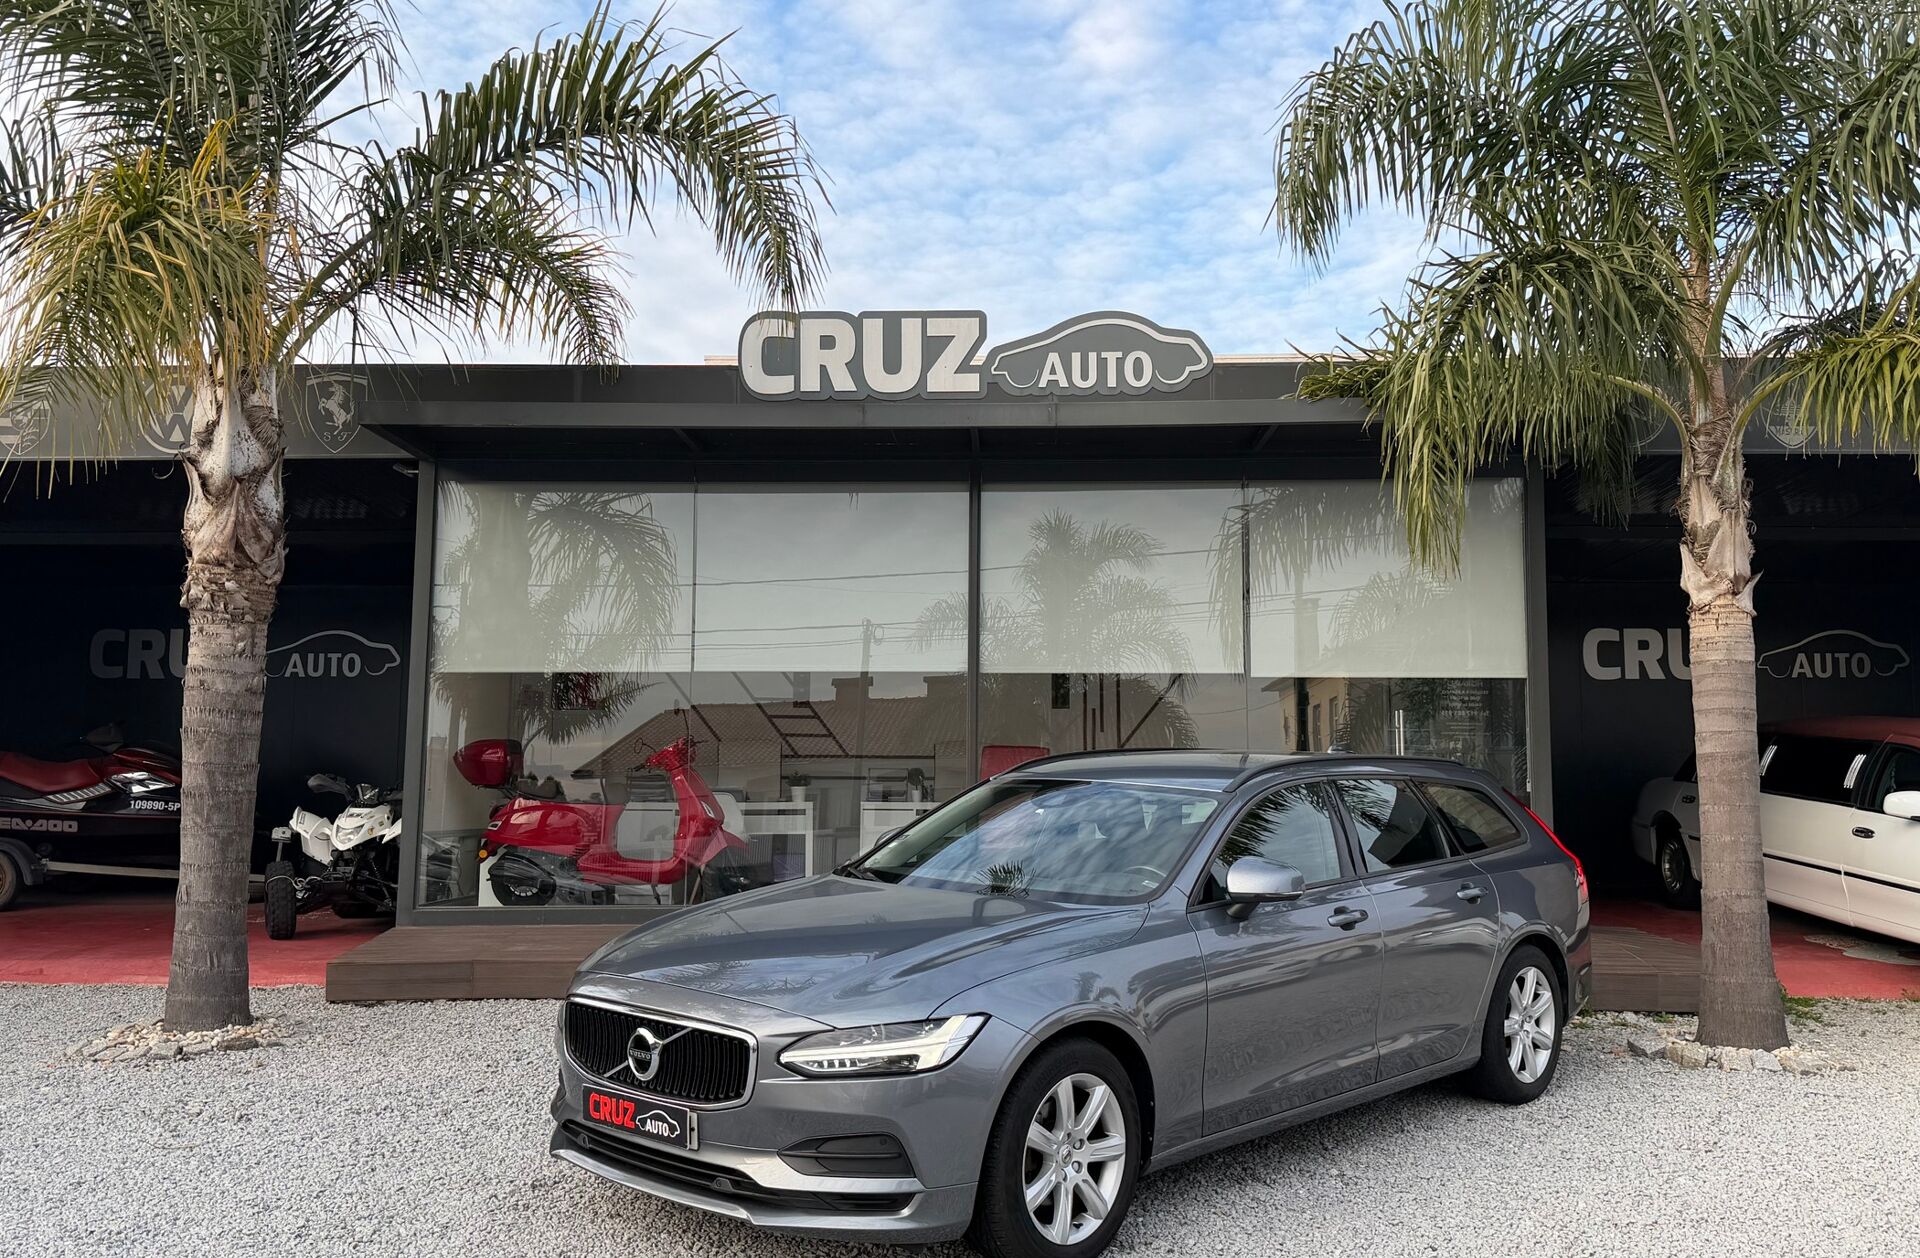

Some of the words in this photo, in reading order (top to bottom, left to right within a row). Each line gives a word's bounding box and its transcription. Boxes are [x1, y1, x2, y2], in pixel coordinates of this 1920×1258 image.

[741, 317, 980, 395] CRUZ
[1038, 350, 1153, 389] AUTO
[88, 628, 188, 680] CR
[284, 652, 362, 678] AUTO
[1582, 627, 1692, 680] CRU
[1791, 652, 1872, 679] AUTO
[629, 1049, 651, 1060] VOLVO
[589, 1091, 636, 1129] CRUZ
[645, 1118, 670, 1137] AUTO
